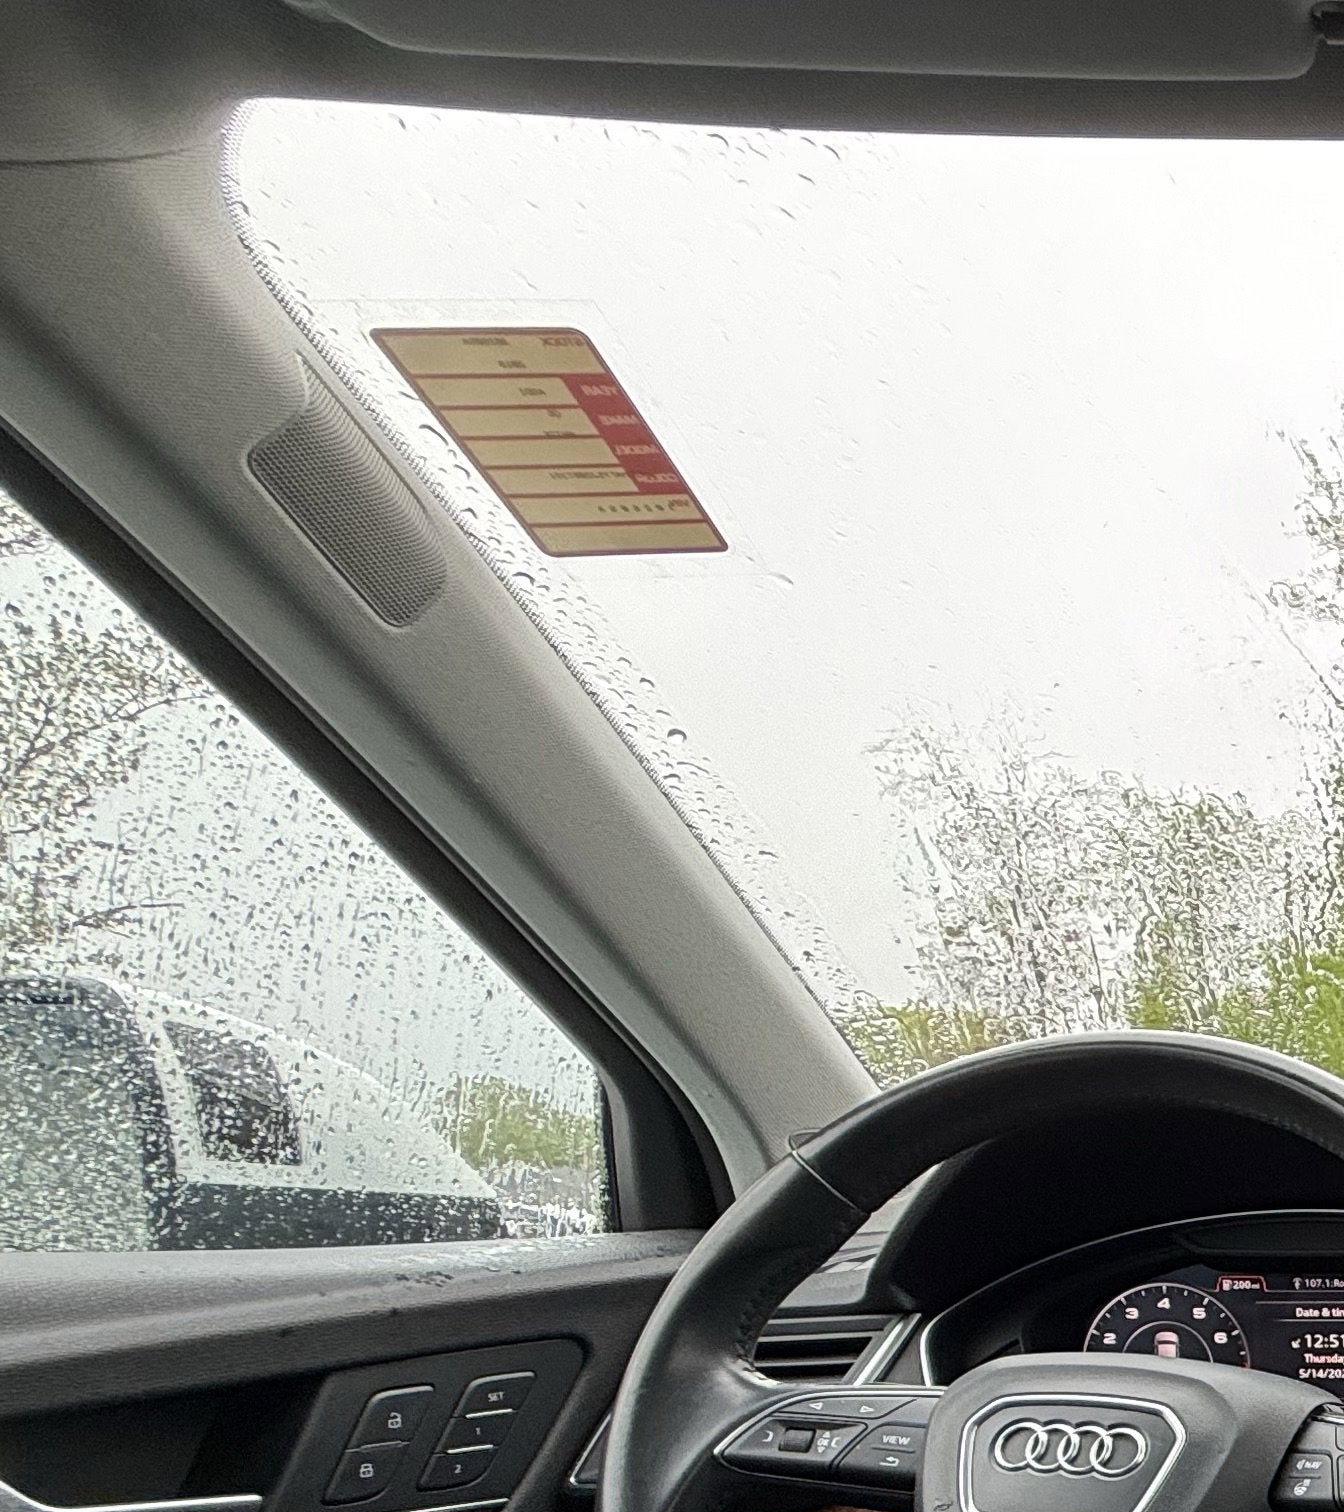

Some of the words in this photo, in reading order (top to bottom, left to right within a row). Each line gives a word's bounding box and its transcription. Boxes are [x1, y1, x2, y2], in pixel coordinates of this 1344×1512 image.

[1156, 1297, 1171, 1310] 4
[1125, 1307, 1140, 1320] 3
[1192, 1307, 1207, 1320] 5
[1295, 1308, 1320, 1318] Date
[1321, 1308, 1331, 1318] &
[1102, 1332, 1117, 1345] 2
[1213, 1331, 1228, 1344] 6
[475, 1427, 481, 1436] 1
[882, 1434, 911, 1446] VIEW
[454, 1464, 462, 1474] 2
